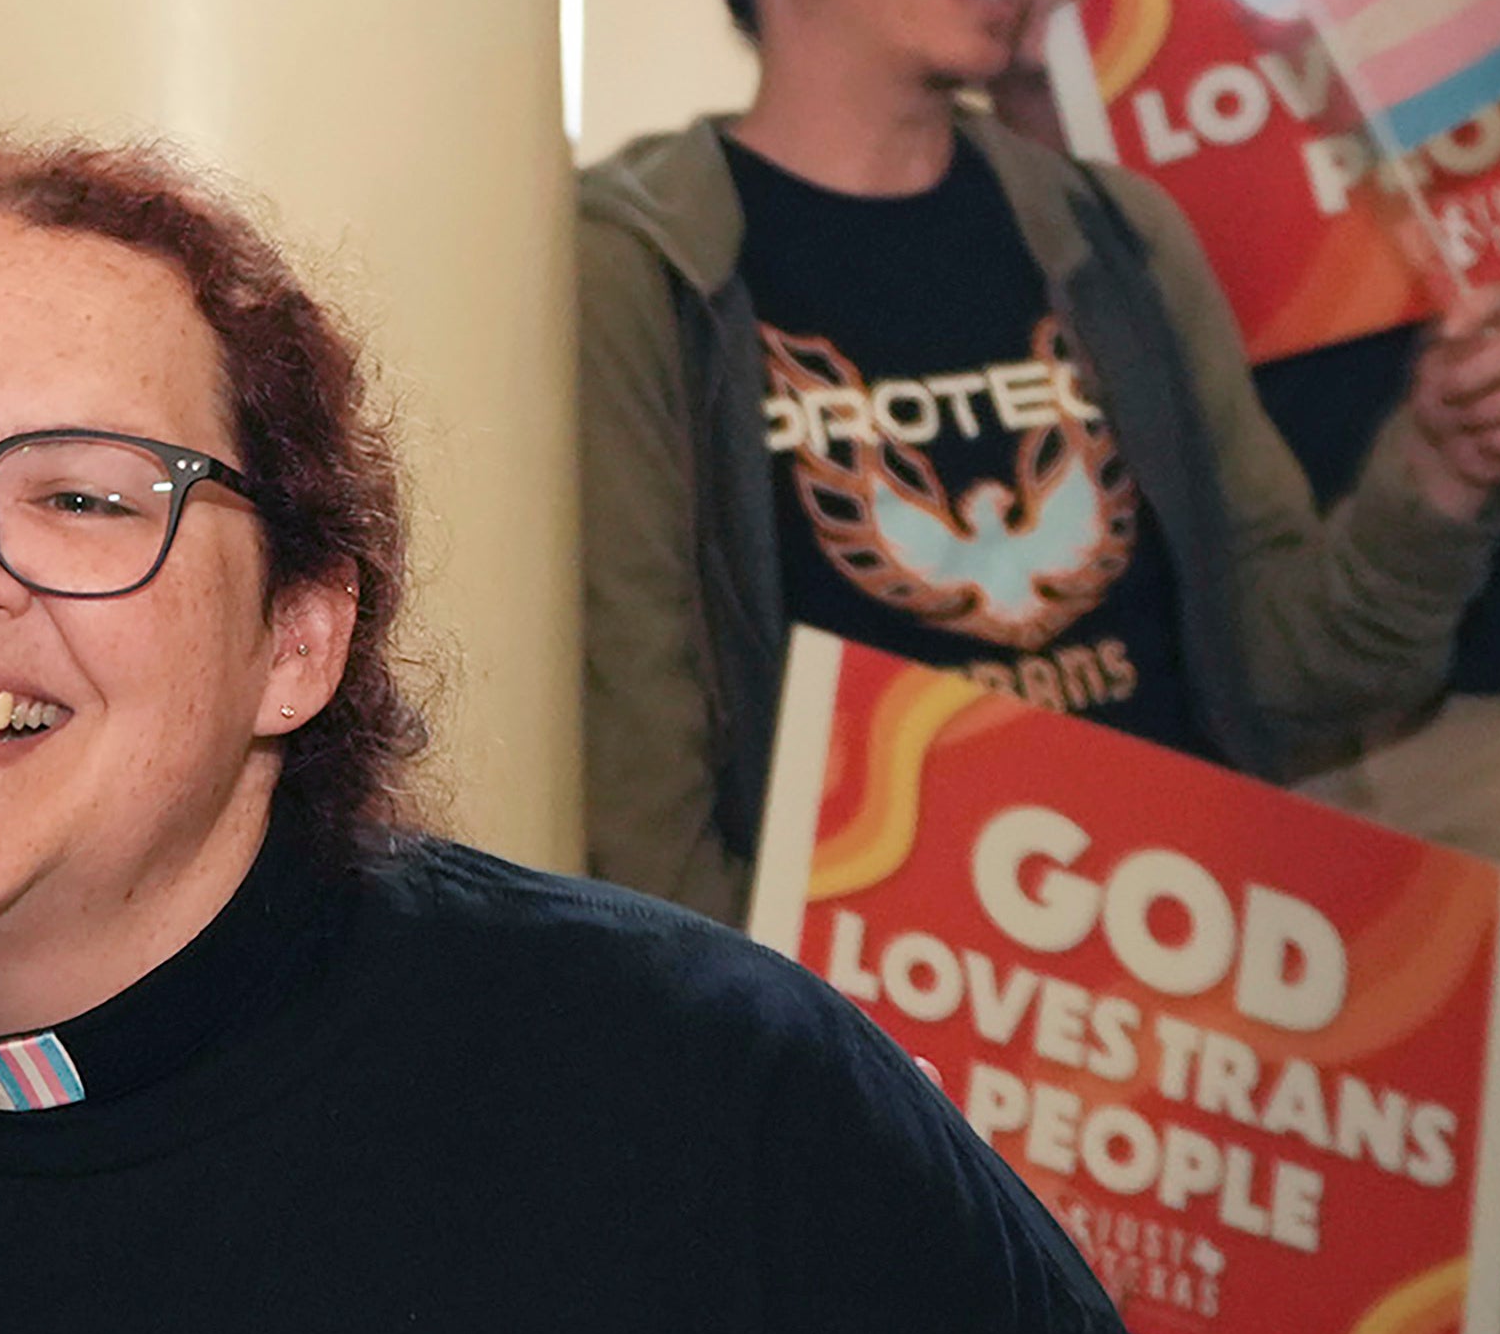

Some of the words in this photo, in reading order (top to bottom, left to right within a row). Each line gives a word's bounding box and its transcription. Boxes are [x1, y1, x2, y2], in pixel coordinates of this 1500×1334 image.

[1132, 37, 1345, 163] LOV
[970, 804, 1348, 1032] GOD
[828, 909, 1142, 1083] LOVES
[1152, 1013, 1459, 1187] TRANS
[962, 1062, 1325, 1255] PEOPLE
